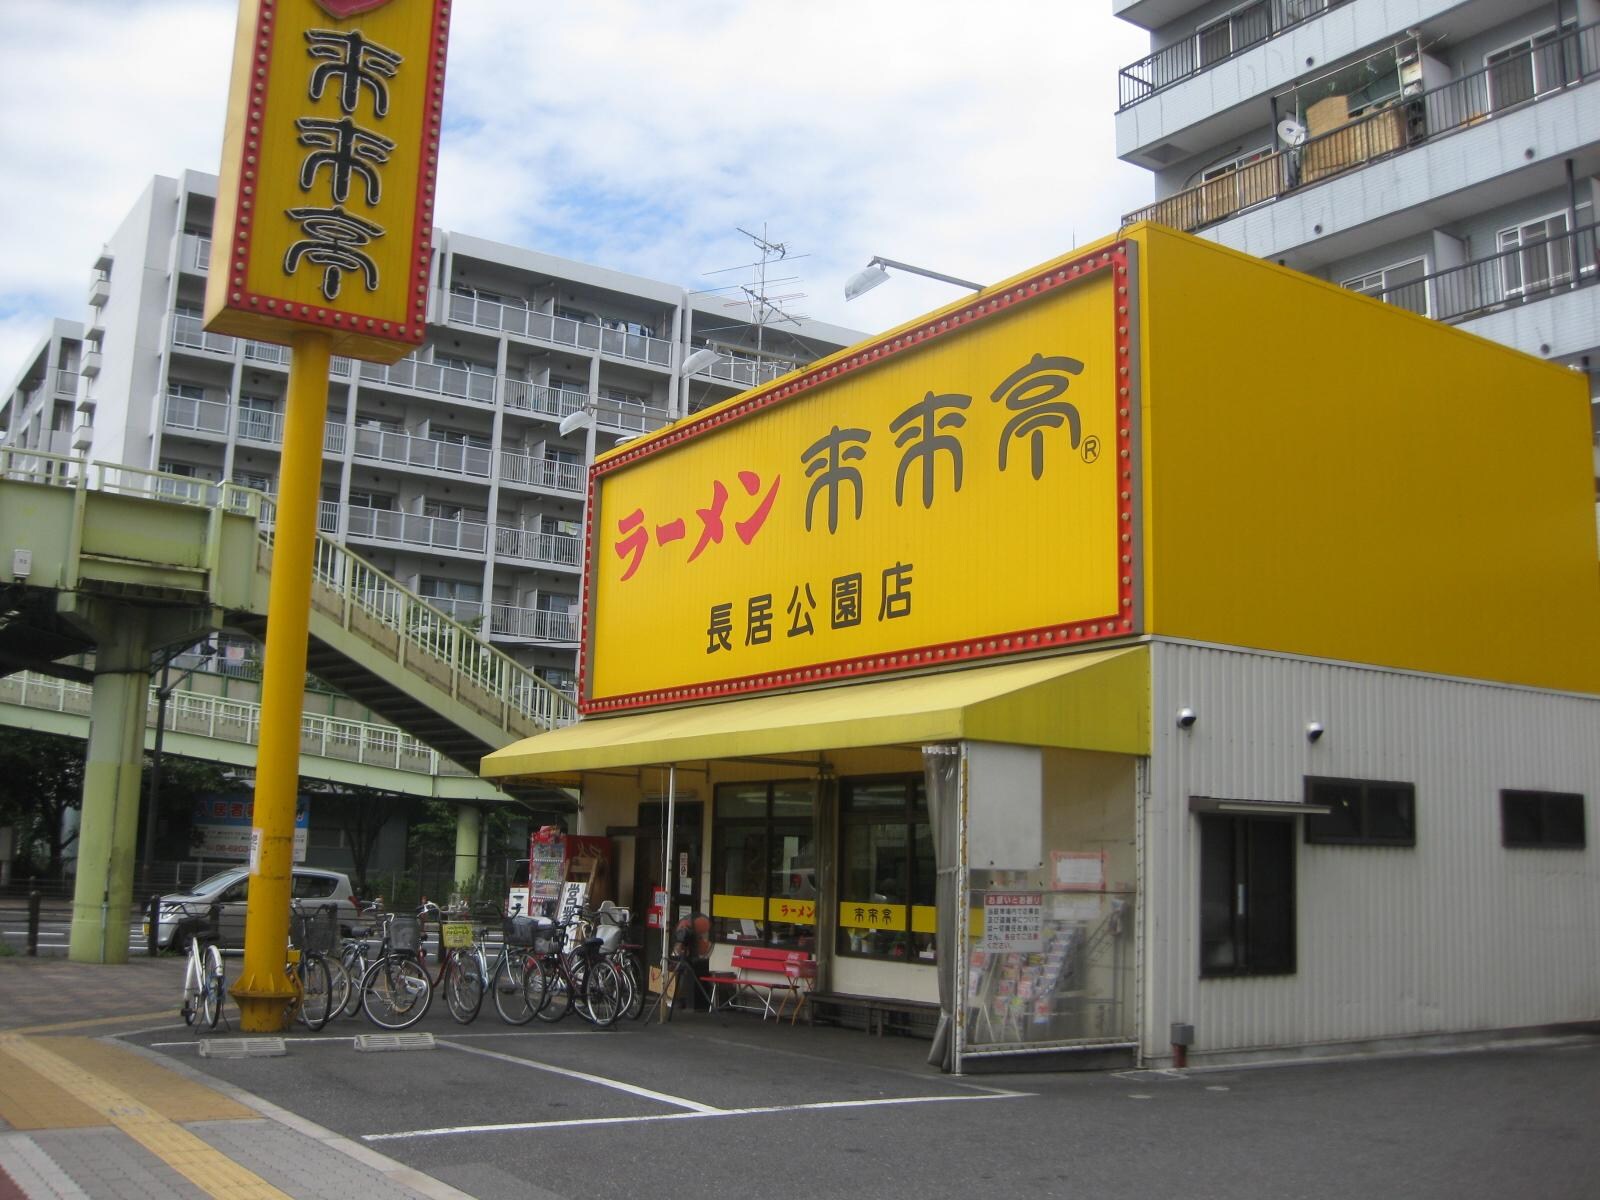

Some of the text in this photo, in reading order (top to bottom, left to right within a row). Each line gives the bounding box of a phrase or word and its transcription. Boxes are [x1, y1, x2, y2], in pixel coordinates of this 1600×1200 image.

[283, 28, 405, 301] 来来亭
[615, 471, 780, 582] ラーメン
[800, 353, 1085, 535] 来来亭
[706, 561, 913, 654] 長居公園店
